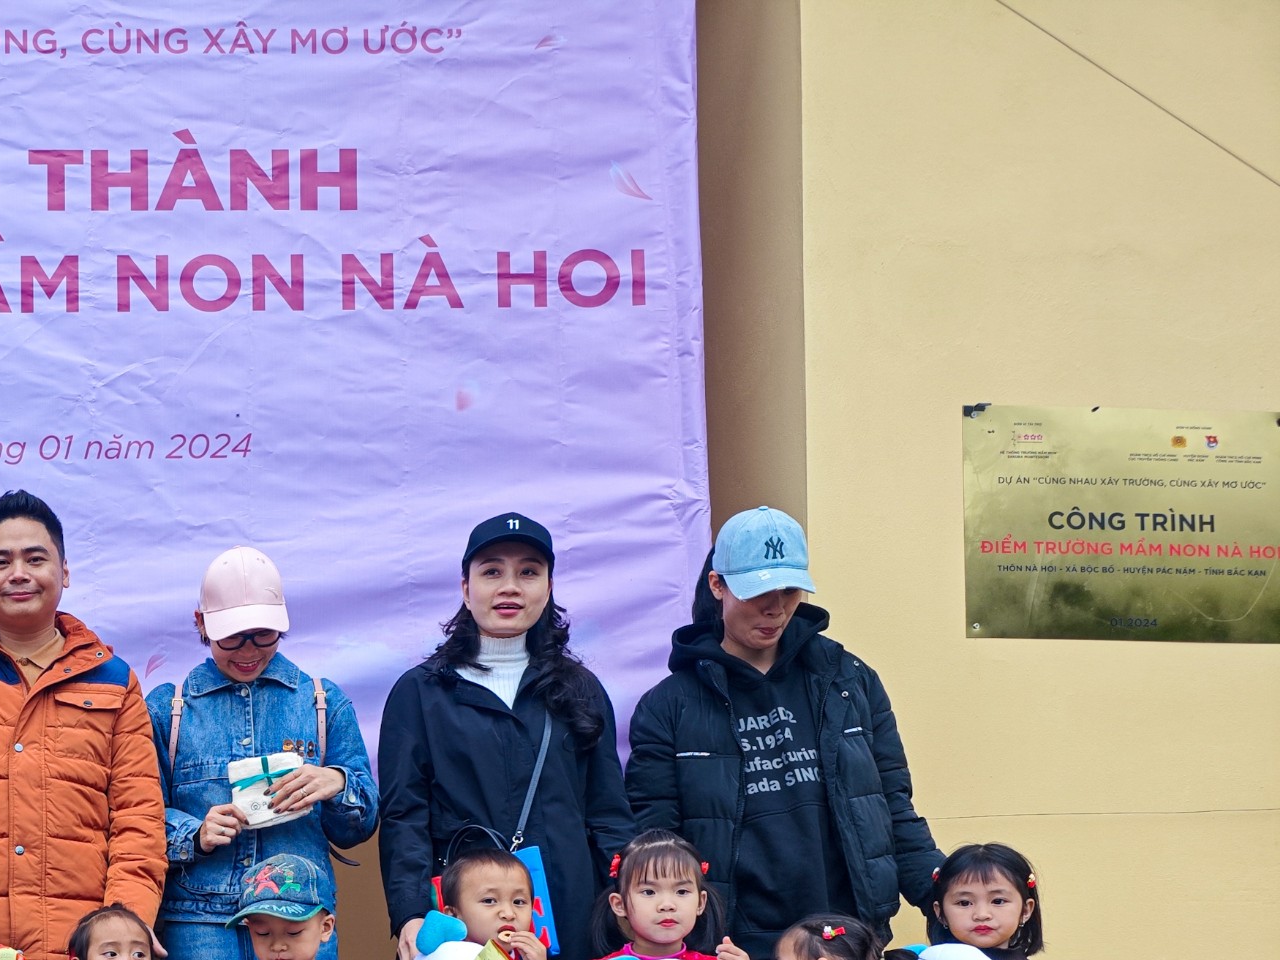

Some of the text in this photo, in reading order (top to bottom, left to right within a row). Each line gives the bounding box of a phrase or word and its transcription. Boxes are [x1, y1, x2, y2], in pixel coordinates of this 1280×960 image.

[81, 22, 189, 55] CÙNG
[204, 22, 277, 54] XÂY
[292, 26, 350, 54] MƠ
[28, 129, 359, 212] THÀNH
[117, 253, 305, 313] NON
[341, 235, 465, 311] NÀ
[496, 248, 647, 309] HOI
[39, 435, 75, 462] 01
[85, 435, 155, 461] năm
[167, 433, 253, 460] 2024
[1016, 475, 1030, 485] ÁN
[1069, 478, 1097, 486] NHAU
[1100, 477, 1119, 486] XÂY
[1170, 478, 1197, 488] CÙNG
[1201, 479, 1219, 488] XÂY
[1222, 480, 1237, 489] MƠ
[506, 519, 520, 530] 11
[1048, 506, 1215, 533] CÔNG TRÌNH
[980, 533, 1280, 559] ĐIỂM TRƯỜNG MẦM NON NÀ HOI
[997, 563, 1023, 573] THÔN
[1026, 564, 1038, 573] NÀ
[1123, 565, 1154, 576] HUYỆN
[1248, 570, 1267, 578] KẠN
[1110, 617, 1158, 629] 01.2024
